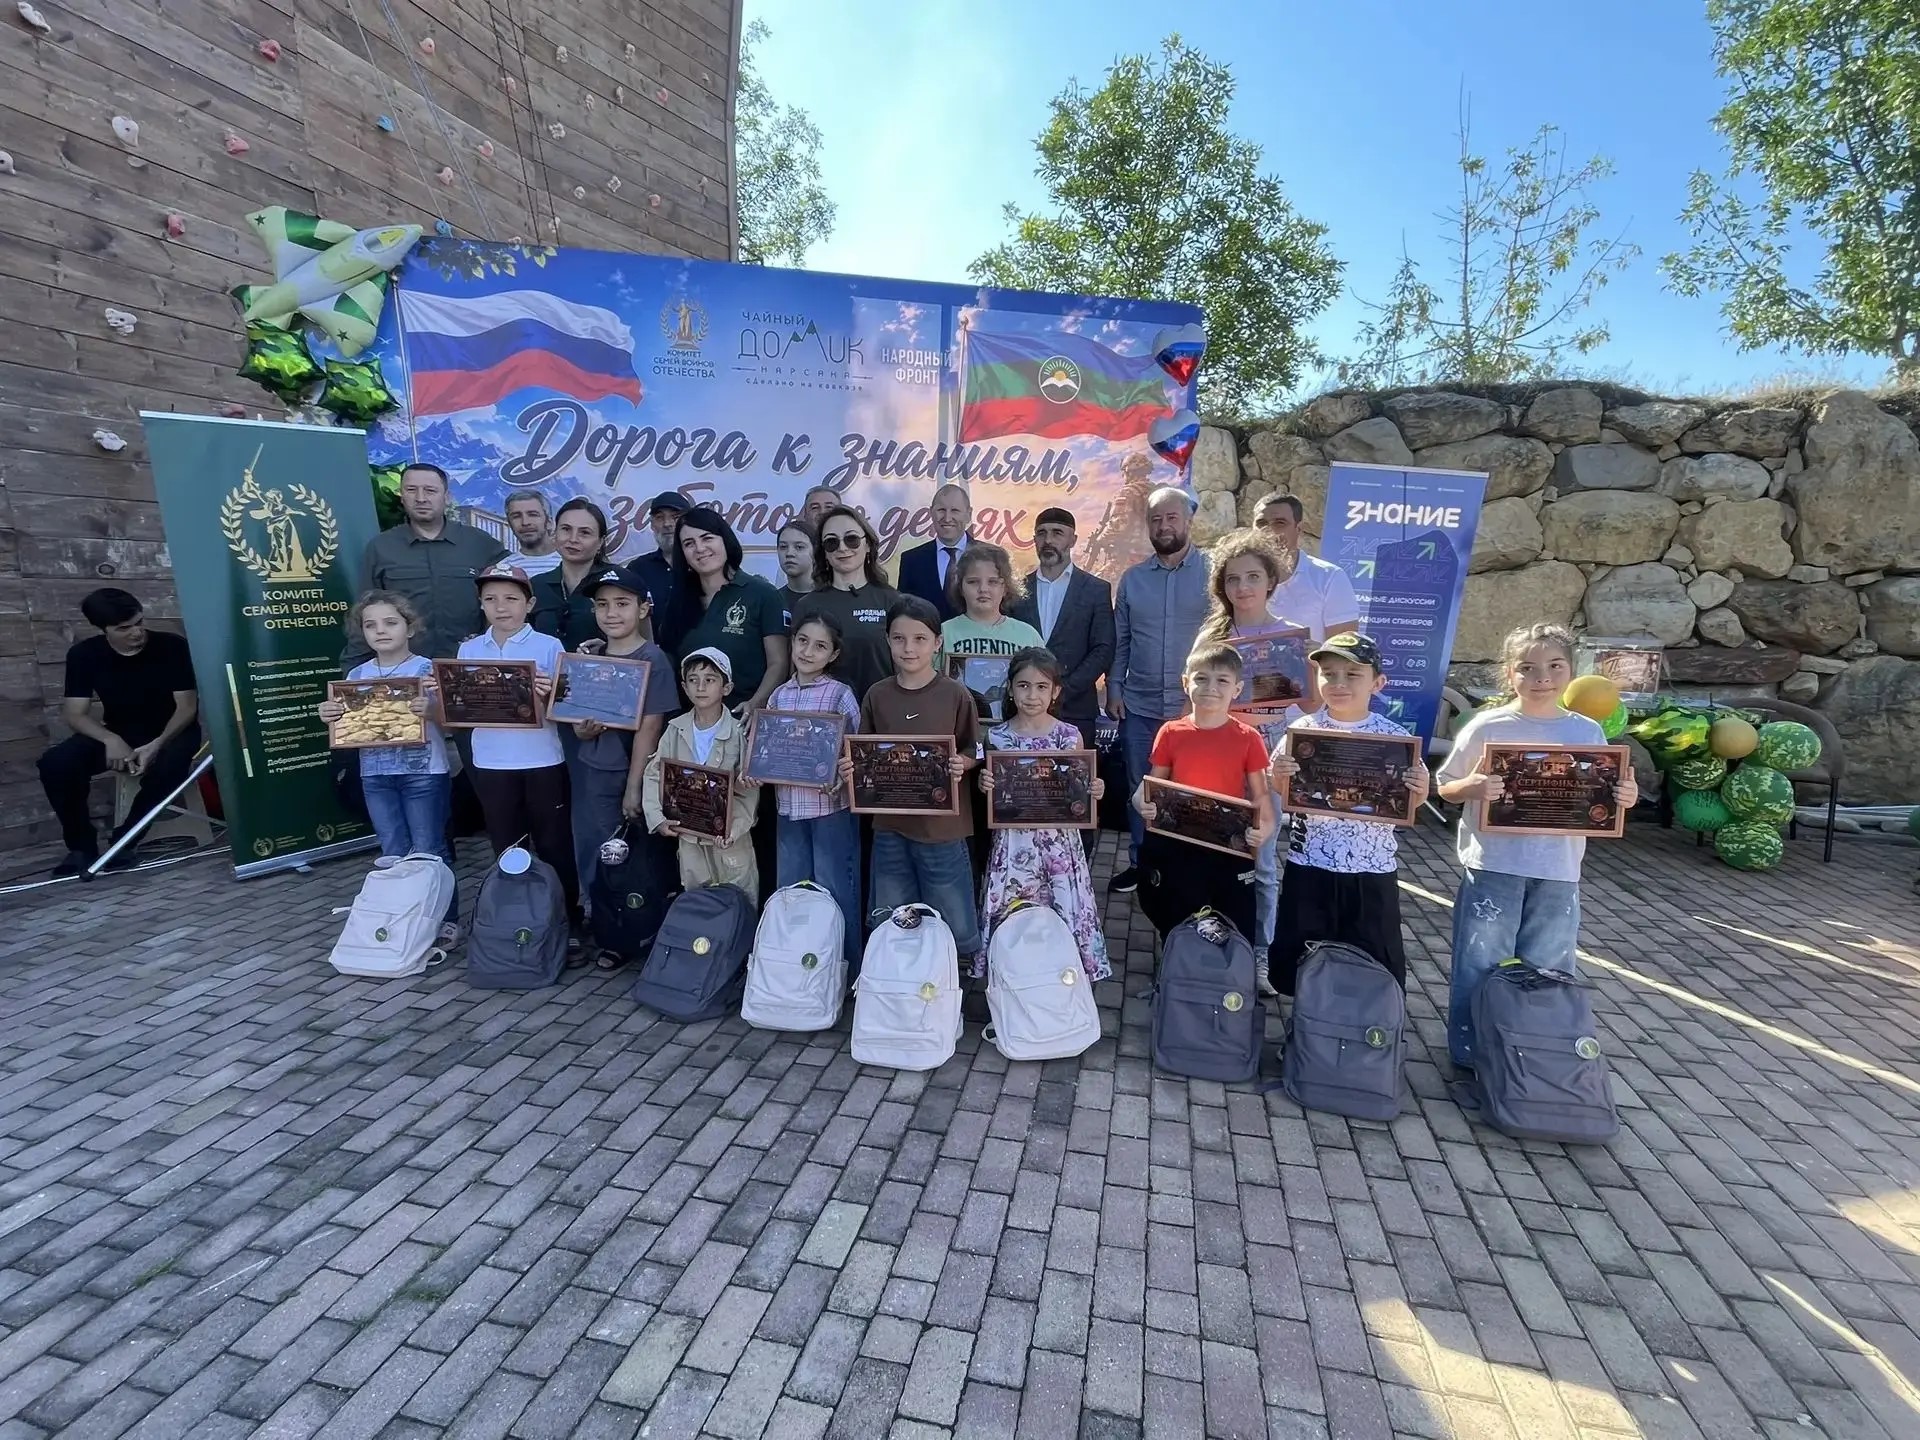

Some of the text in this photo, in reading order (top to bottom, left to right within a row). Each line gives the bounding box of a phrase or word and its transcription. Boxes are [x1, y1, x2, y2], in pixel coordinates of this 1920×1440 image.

[742, 311, 805, 326] ЧАЙНЫЙ
[737, 319, 864, 366] ДОМИК
[667, 349, 702, 358] КОМИТЕТ
[881, 347, 952, 368] НАРОДНЫЙ
[653, 356, 715, 368] СЕМЕЙ ВОИНОВ
[652, 365, 716, 378] ОТЕЧЕСТВА
[895, 367, 938, 385] ФРОНТ
[500, 397, 1081, 494] Дорога к знаниям,
[1344, 500, 1462, 530] ЗНАНИЕ
[262, 588, 325, 601] КОМИТЕТ
[242, 601, 349, 617] СЕМЕЙ ВОИНОВ
[852, 609, 887, 617] НАРОДНЫЙ
[264, 615, 338, 630] ОТЕЧЕСТВА
[1391, 638, 1425, 647] ФОРУМЫ
[1385, 679, 1421, 688] НТЕРВЬЮ
